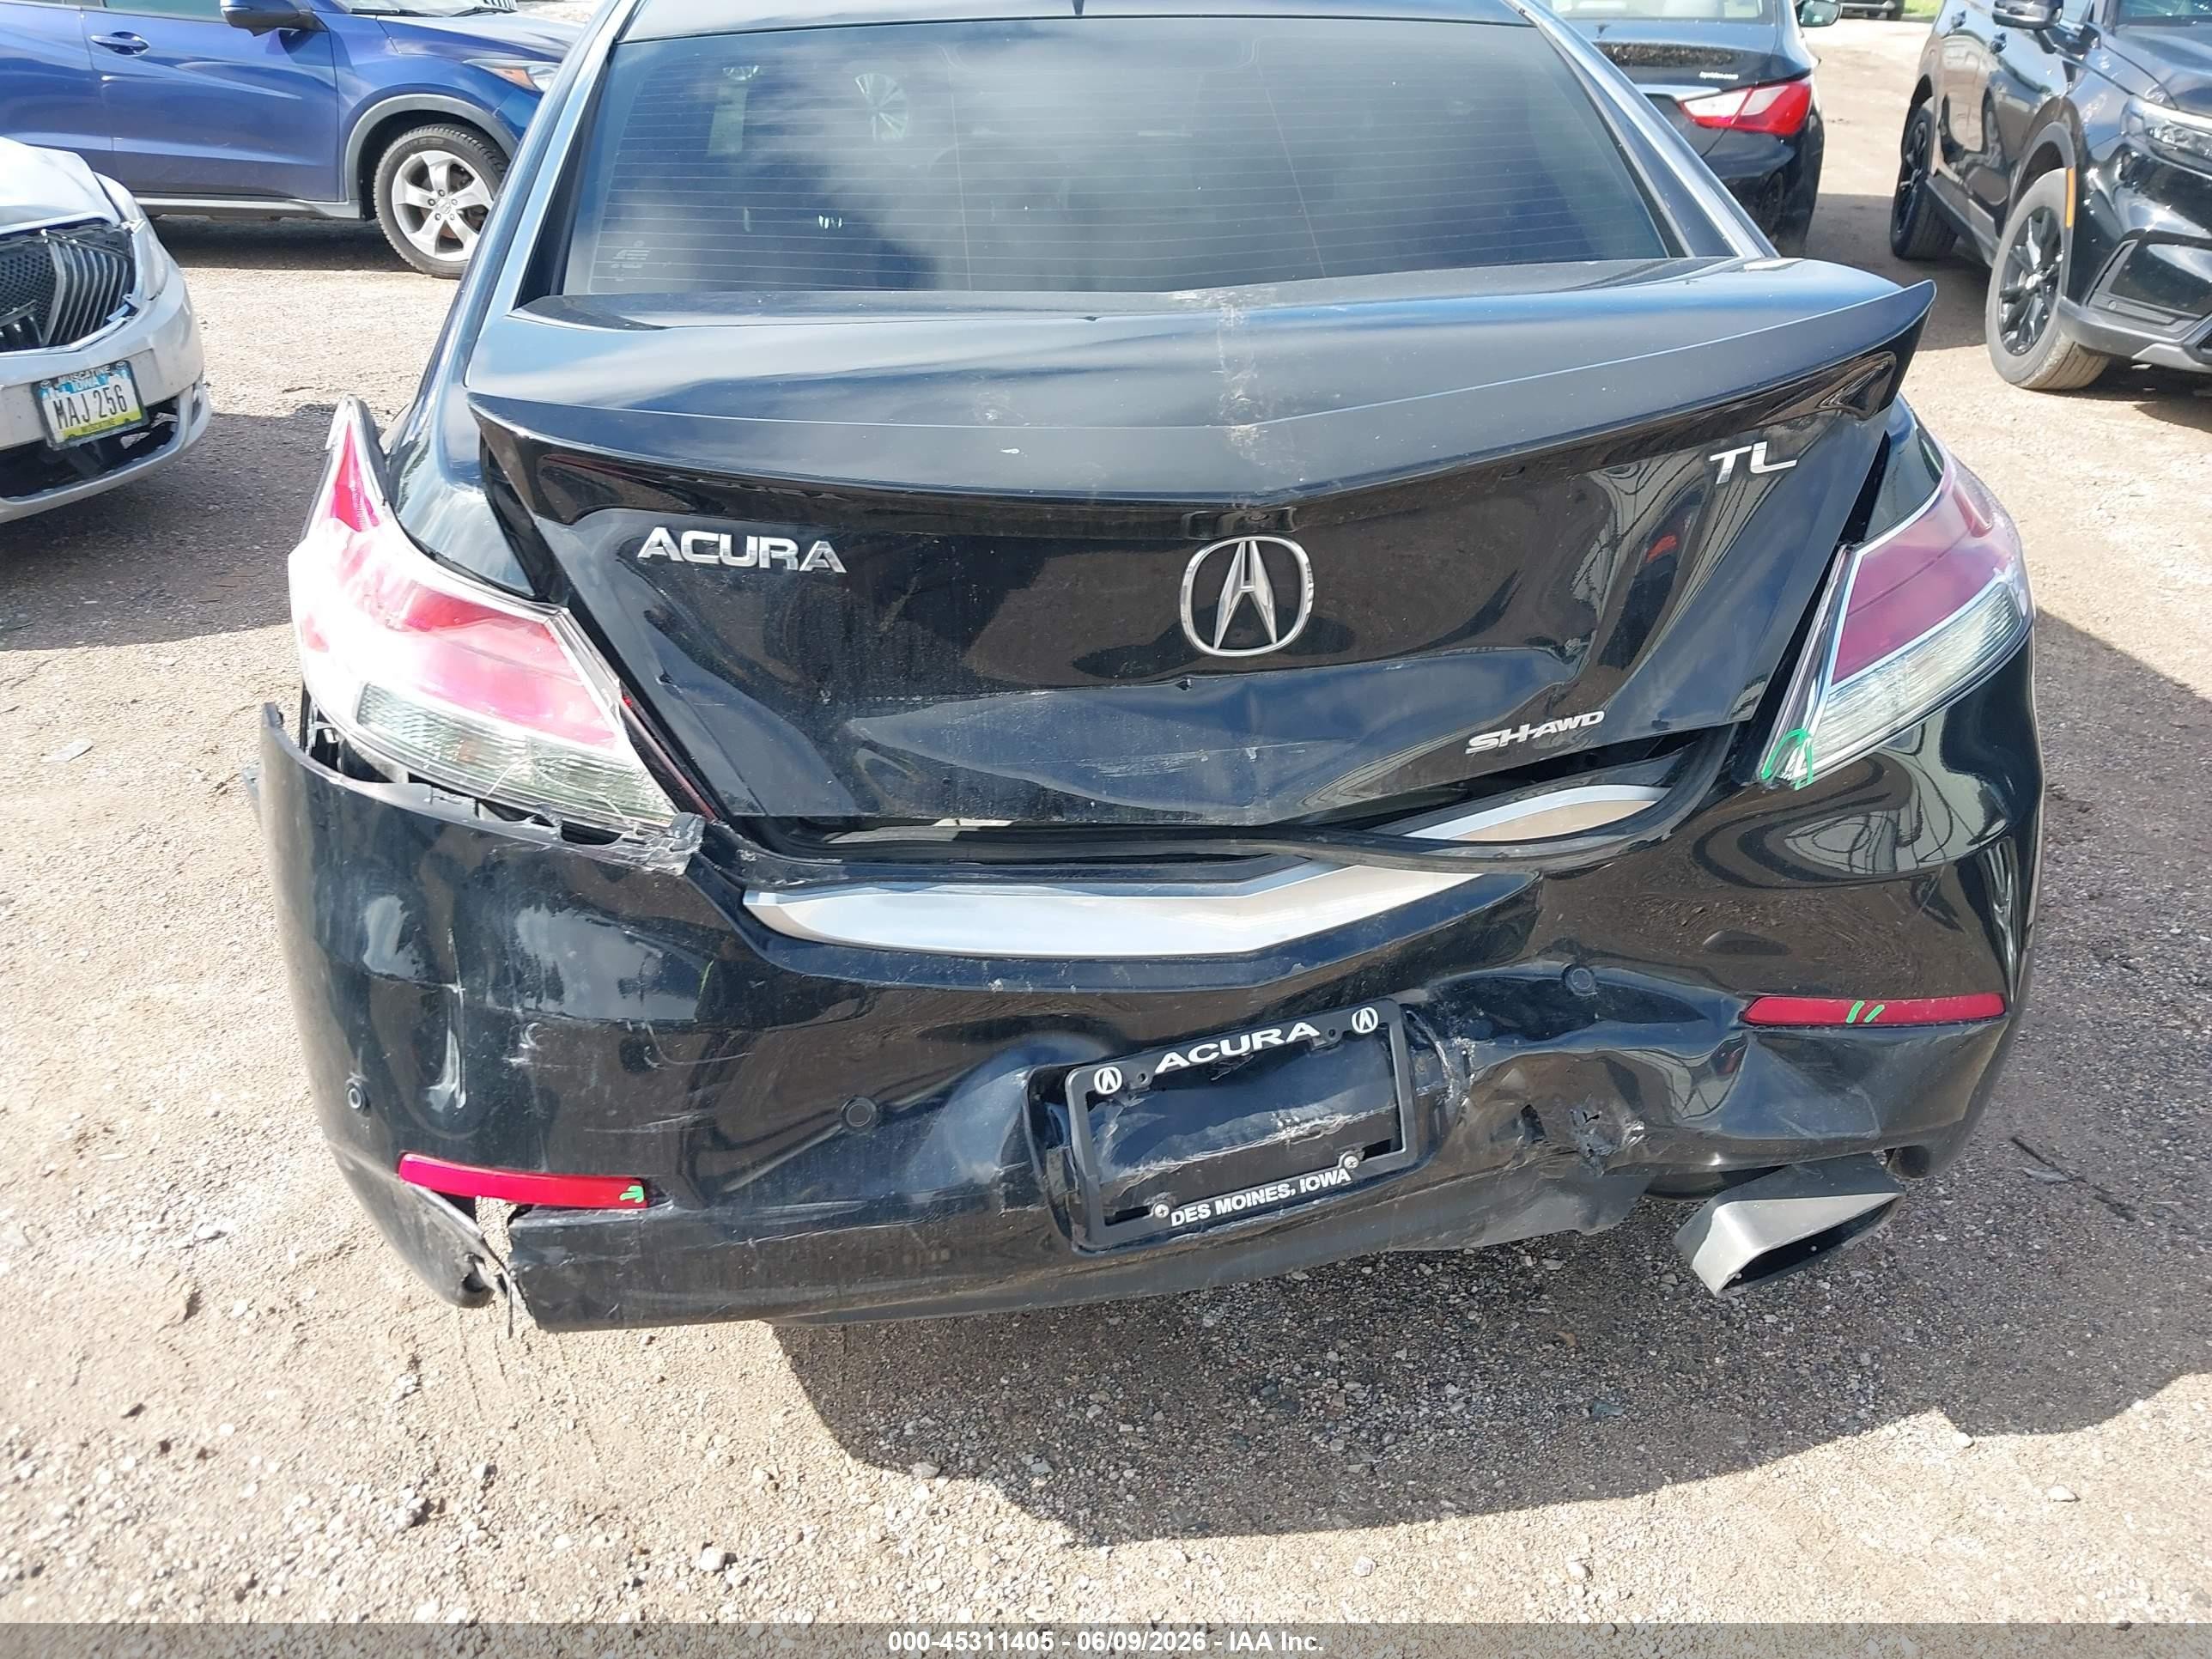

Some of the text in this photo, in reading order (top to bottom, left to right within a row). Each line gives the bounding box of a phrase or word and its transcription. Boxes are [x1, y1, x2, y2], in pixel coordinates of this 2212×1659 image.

[52, 384, 127, 429] MAJ 256
[1709, 441, 1798, 485] TL
[637, 526, 847, 574] ACURA
[1465, 710, 1605, 754] SH-AWD
[1155, 1022, 1321, 1073] ACURA
[1170, 1168, 1352, 1227] DES MOINES, IOWA
